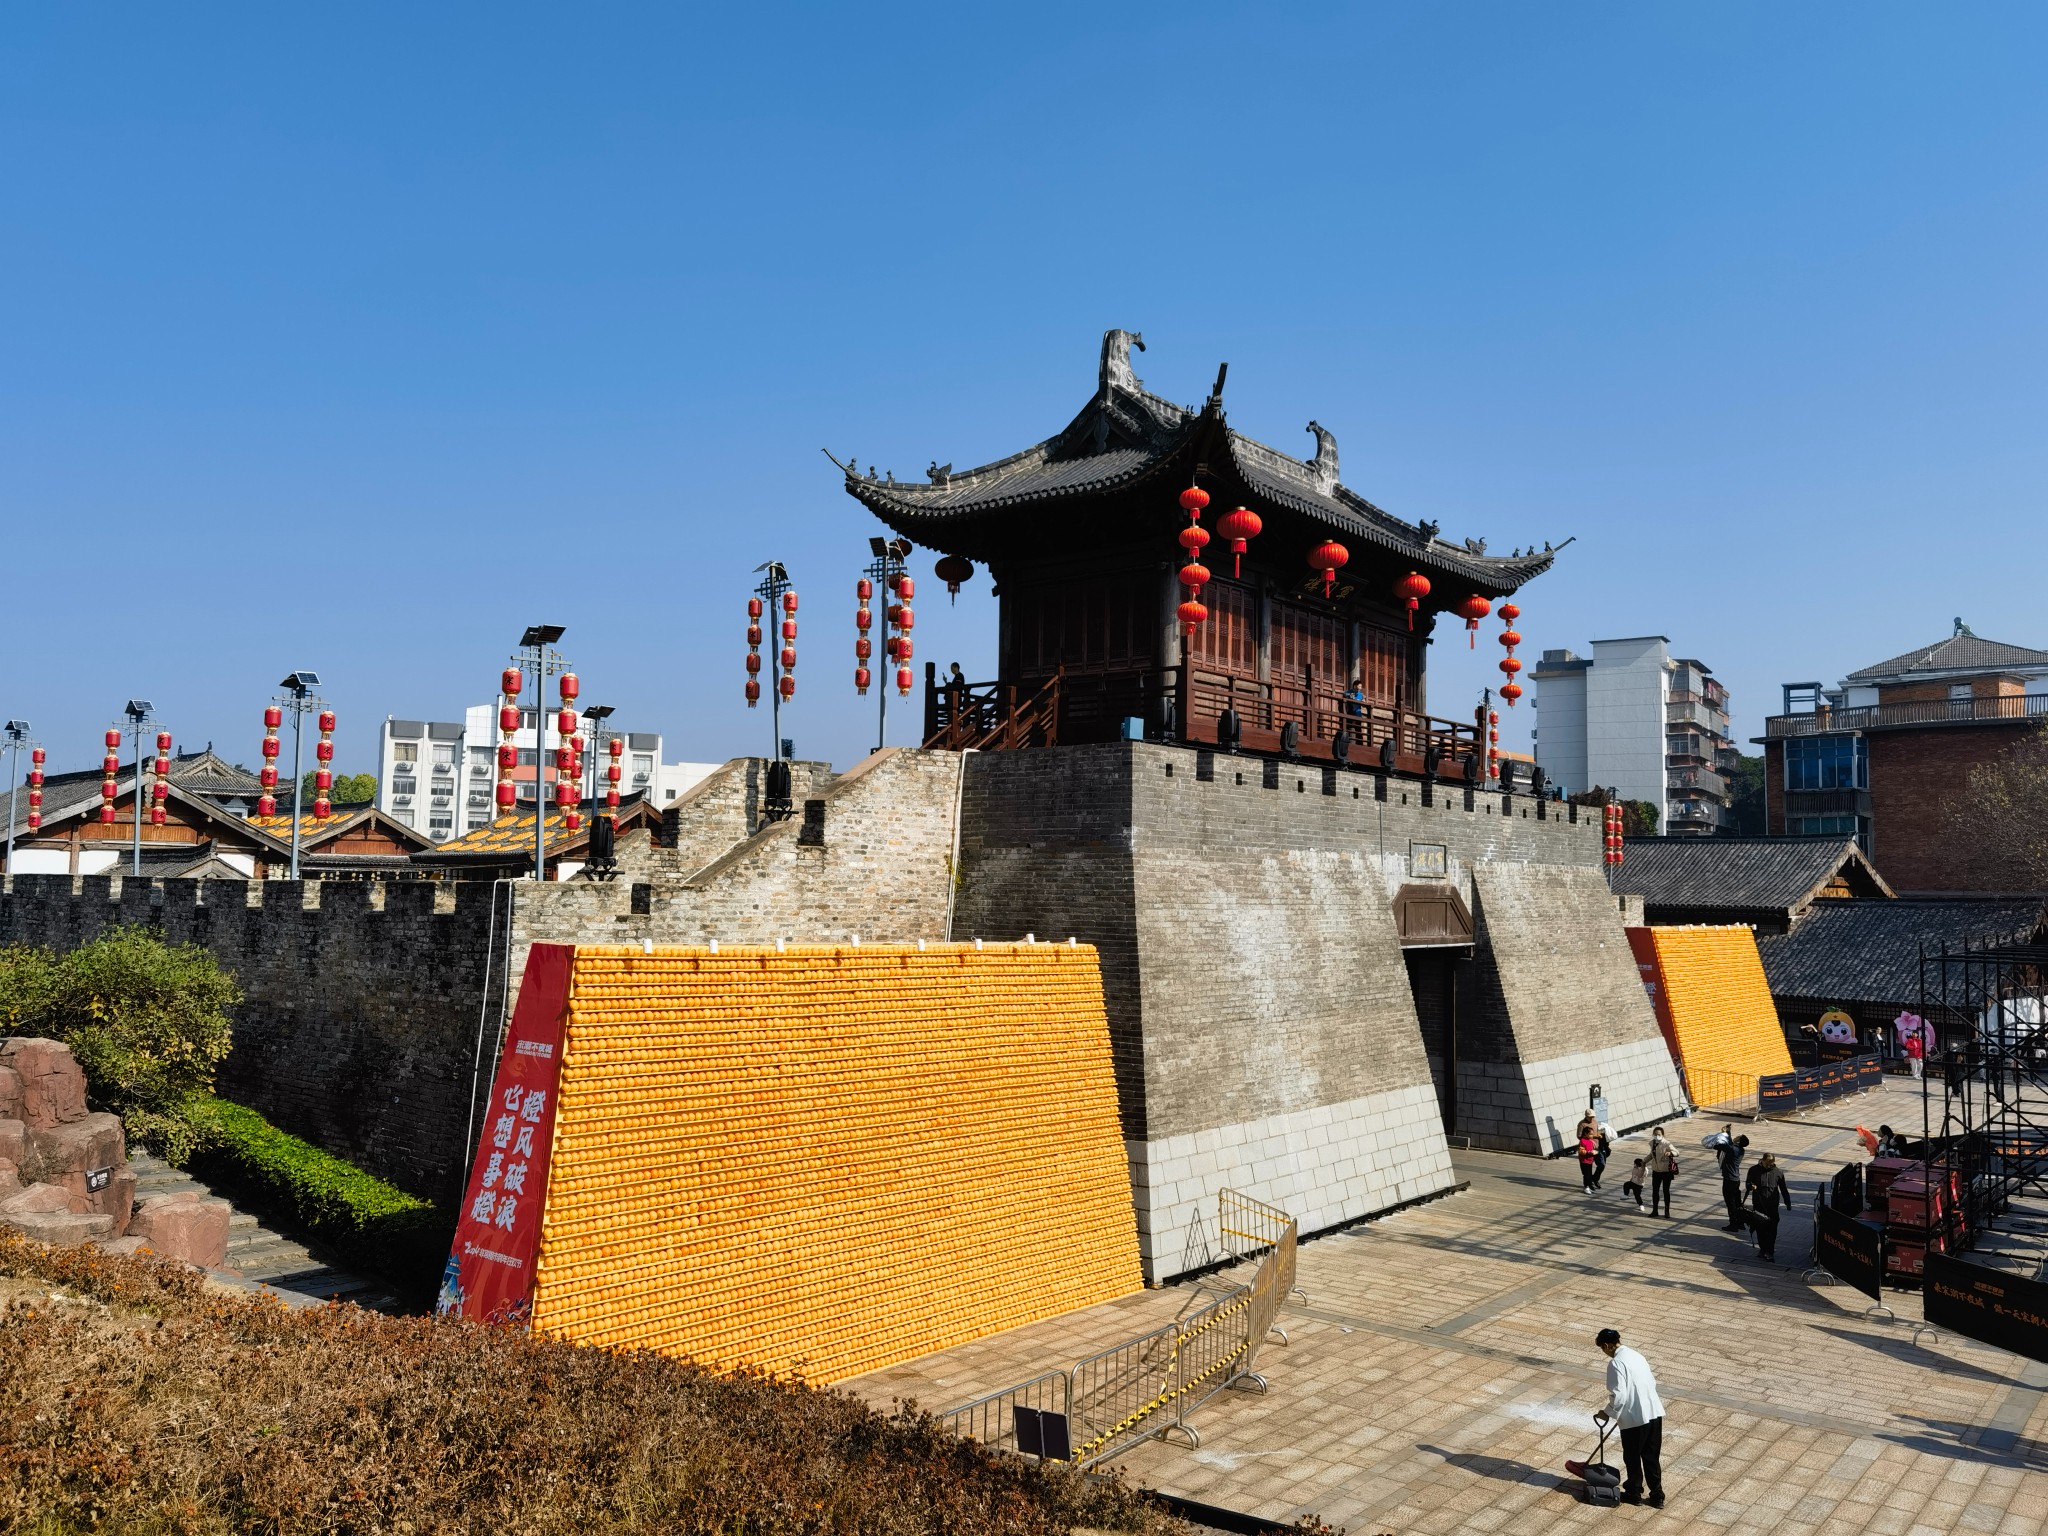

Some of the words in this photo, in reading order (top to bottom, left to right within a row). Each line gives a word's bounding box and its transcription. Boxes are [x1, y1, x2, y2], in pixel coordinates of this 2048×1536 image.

[749, 630, 756, 638] 宋
[904, 644, 911, 652] 宋
[505, 676, 514, 686] 宋
[325, 717, 333, 725] 宋
[268, 741, 276, 750] 宋
[324, 746, 331, 755] 宋
[502, 751, 512, 761] 宋
[561, 752, 569, 762] 宋
[265, 772, 273, 780] 宋
[268, 802, 275, 811] 宋
[321, 804, 329, 813] 宋
[158, 811, 165, 819] 宋
[470, 1084, 524, 1224] 心想事橙
[494, 1089, 547, 1233] 橙风破浪
